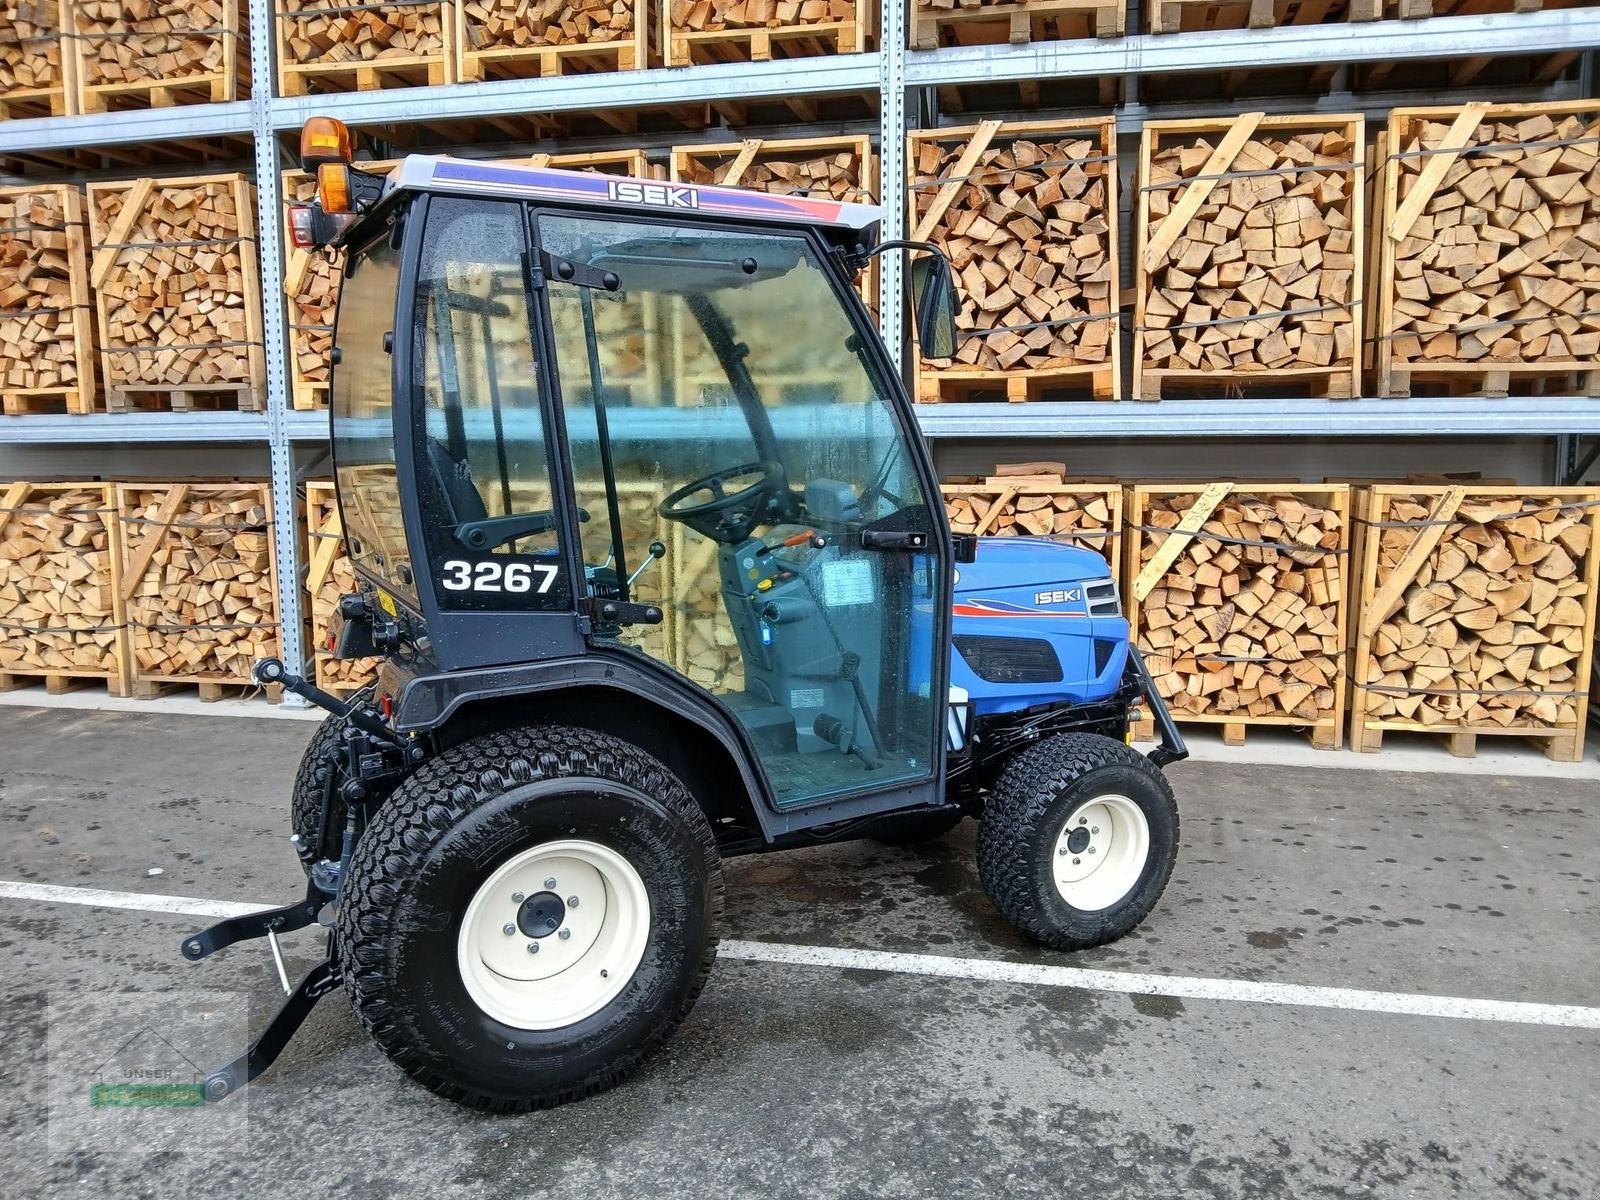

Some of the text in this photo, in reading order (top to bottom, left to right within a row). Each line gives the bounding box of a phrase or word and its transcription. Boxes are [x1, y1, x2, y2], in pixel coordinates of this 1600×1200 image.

[608, 181, 699, 209] ISEKI
[442, 560, 559, 594] 3267
[1034, 589, 1081, 605] ISEKI
